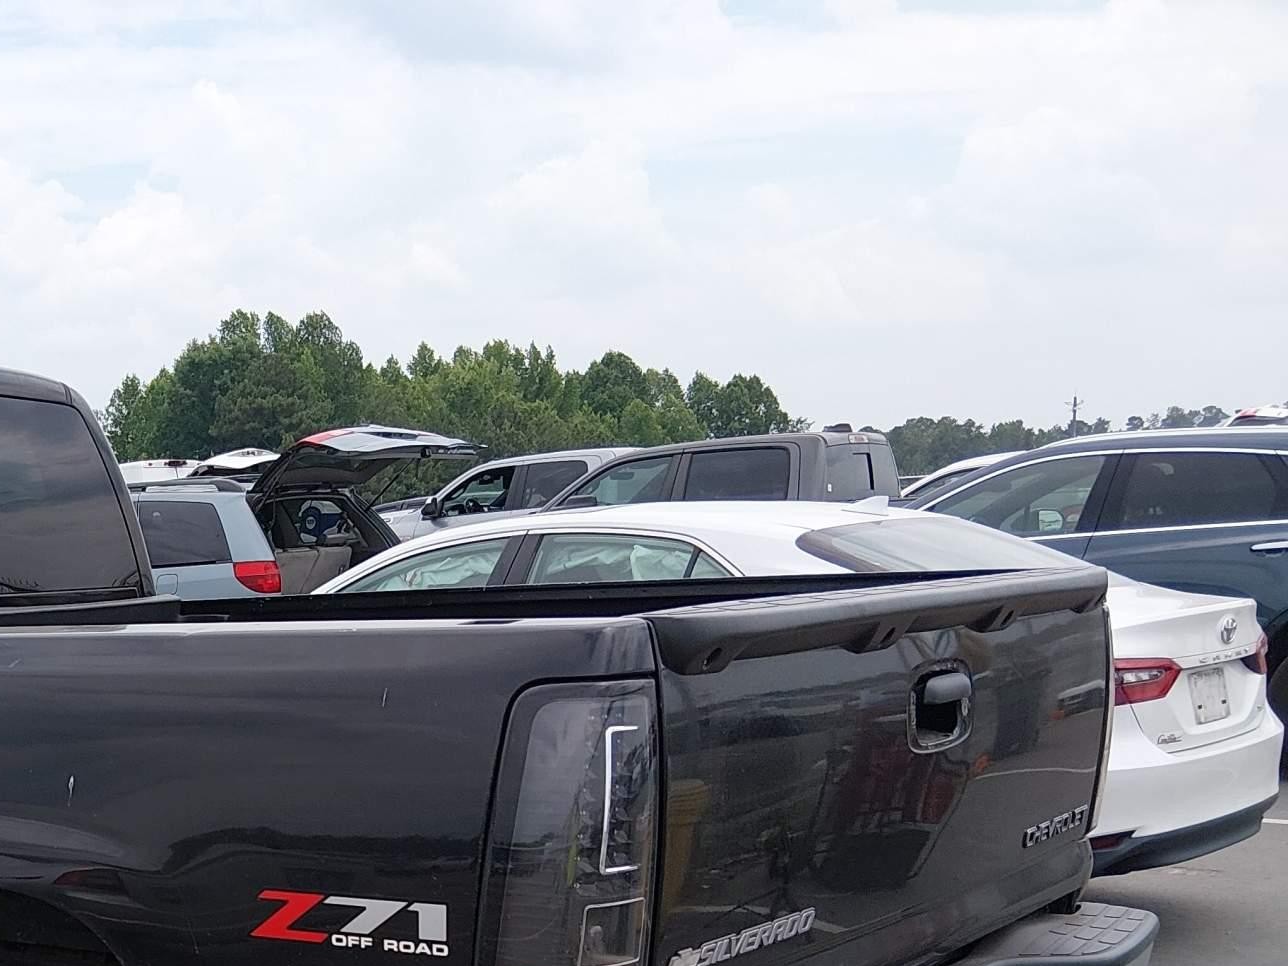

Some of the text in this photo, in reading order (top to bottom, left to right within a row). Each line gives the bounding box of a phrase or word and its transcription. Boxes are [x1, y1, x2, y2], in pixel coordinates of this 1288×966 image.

[1022, 805, 1089, 849] CHEVROLET
[249, 889, 448, 944] Z71
[331, 934, 449, 957] OFF ROAD
